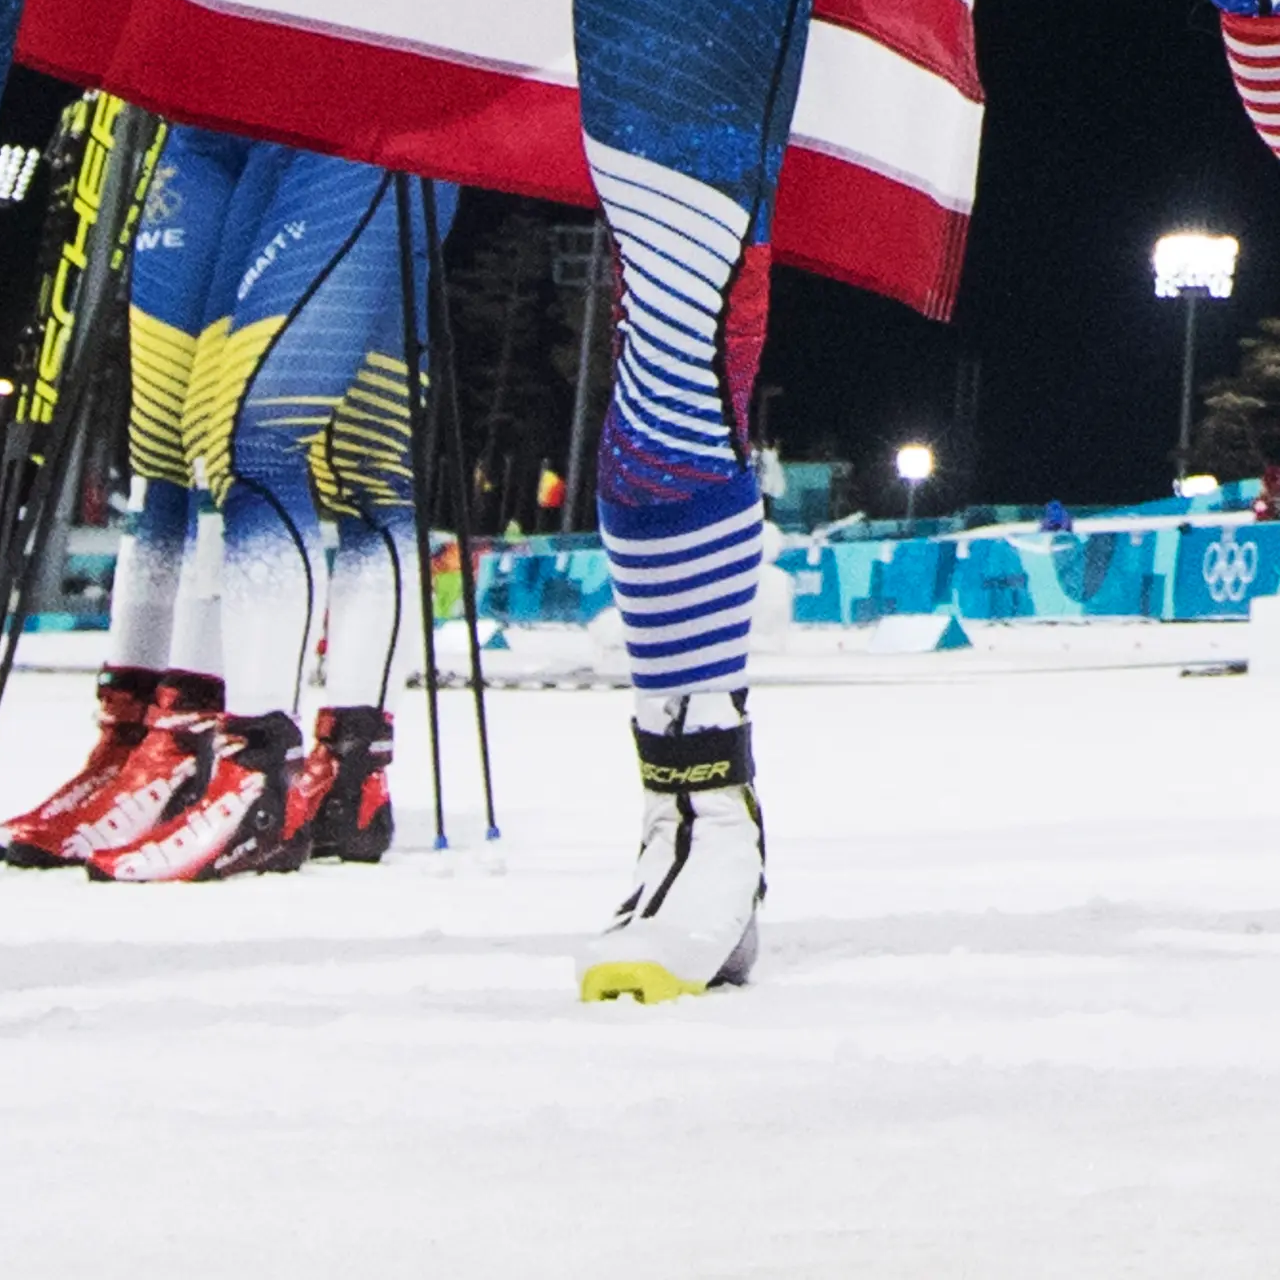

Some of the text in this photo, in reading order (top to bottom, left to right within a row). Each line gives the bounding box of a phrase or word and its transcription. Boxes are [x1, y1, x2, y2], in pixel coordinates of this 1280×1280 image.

[29, 90, 127, 425] FISCHER
[237, 231, 287, 302] CRAFT
[111, 771, 266, 882] alpina
